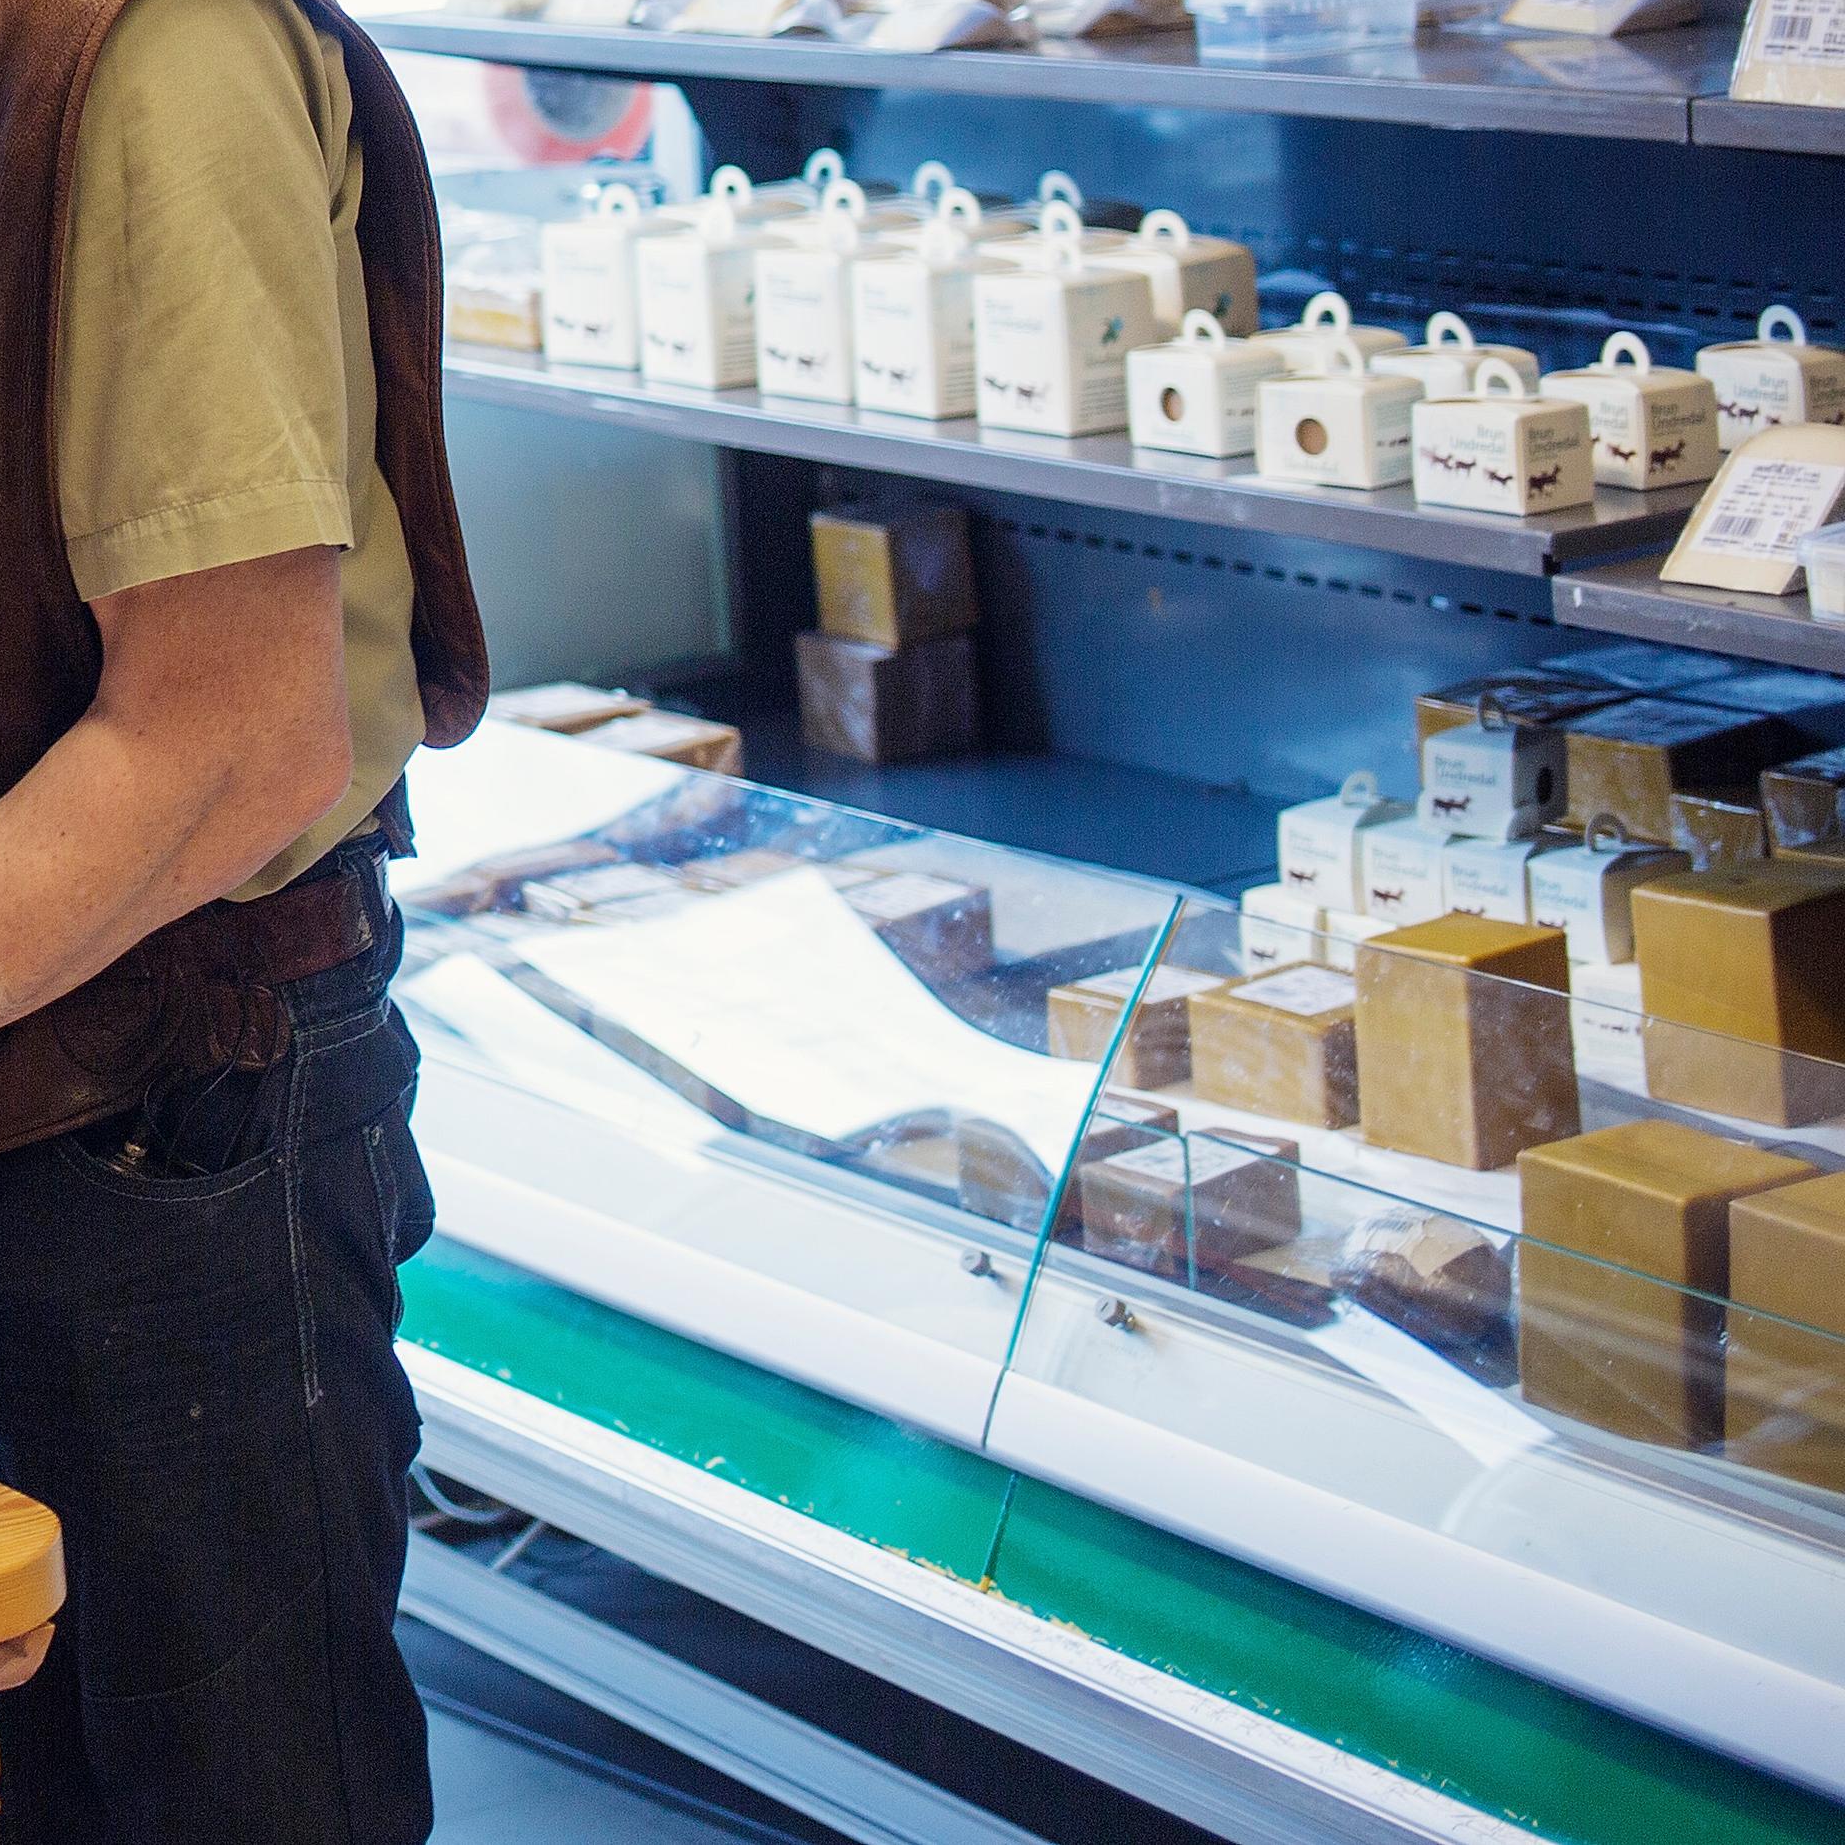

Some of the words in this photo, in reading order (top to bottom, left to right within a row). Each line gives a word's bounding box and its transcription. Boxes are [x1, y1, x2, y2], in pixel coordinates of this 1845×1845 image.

[1760, 373, 1789, 388] Brun
[1592, 414, 1629, 430] dredal
[1477, 424, 1506, 441] Brun
[1449, 435, 1507, 455] Undredal
